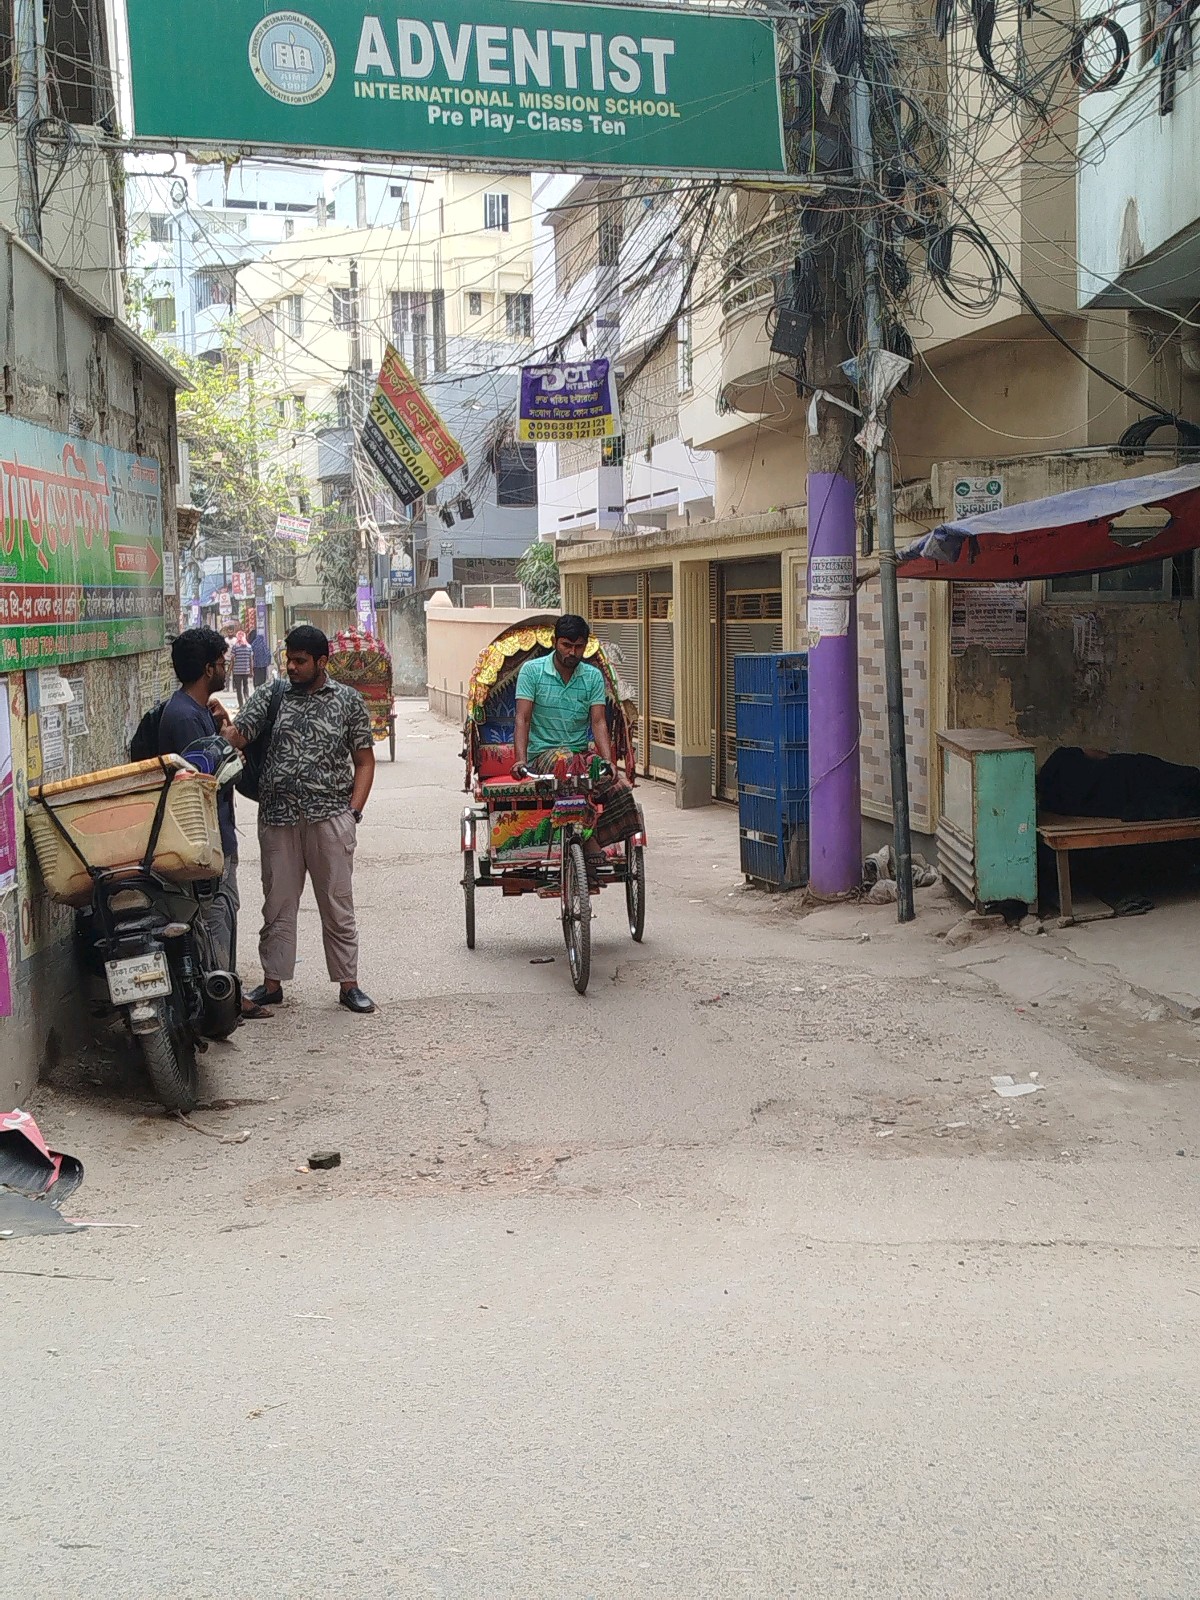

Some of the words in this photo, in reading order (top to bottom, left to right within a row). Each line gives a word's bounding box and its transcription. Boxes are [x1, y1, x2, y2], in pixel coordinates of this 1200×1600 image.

[263, 14, 303, 30] INTERNATIONAL
[304, 20, 324, 42] MISSION
[354, 16, 675, 94] ADVENTIST
[264, 82, 290, 102] EDUCATES
[290, 96, 302, 104] FOR
[302, 87, 325, 103] ETERNITY
[354, 81, 513, 108] INTERNATIONAL
[519, 92, 599, 113] MISSION
[605, 100, 681, 118] SCHOOL
[428, 104, 464, 127] Pre
[588, 116, 626, 136] Ten
[405, 399, 458, 466] একাডেমি
[536, 422, 573, 430] 09638
[576, 420, 590, 429] 121
[593, 418, 606, 428] 121
[536, 431, 573, 440] 09639
[576, 430, 590, 438] 121
[593, 428, 606, 436] 121
[385, 428, 430, 486] 579000
